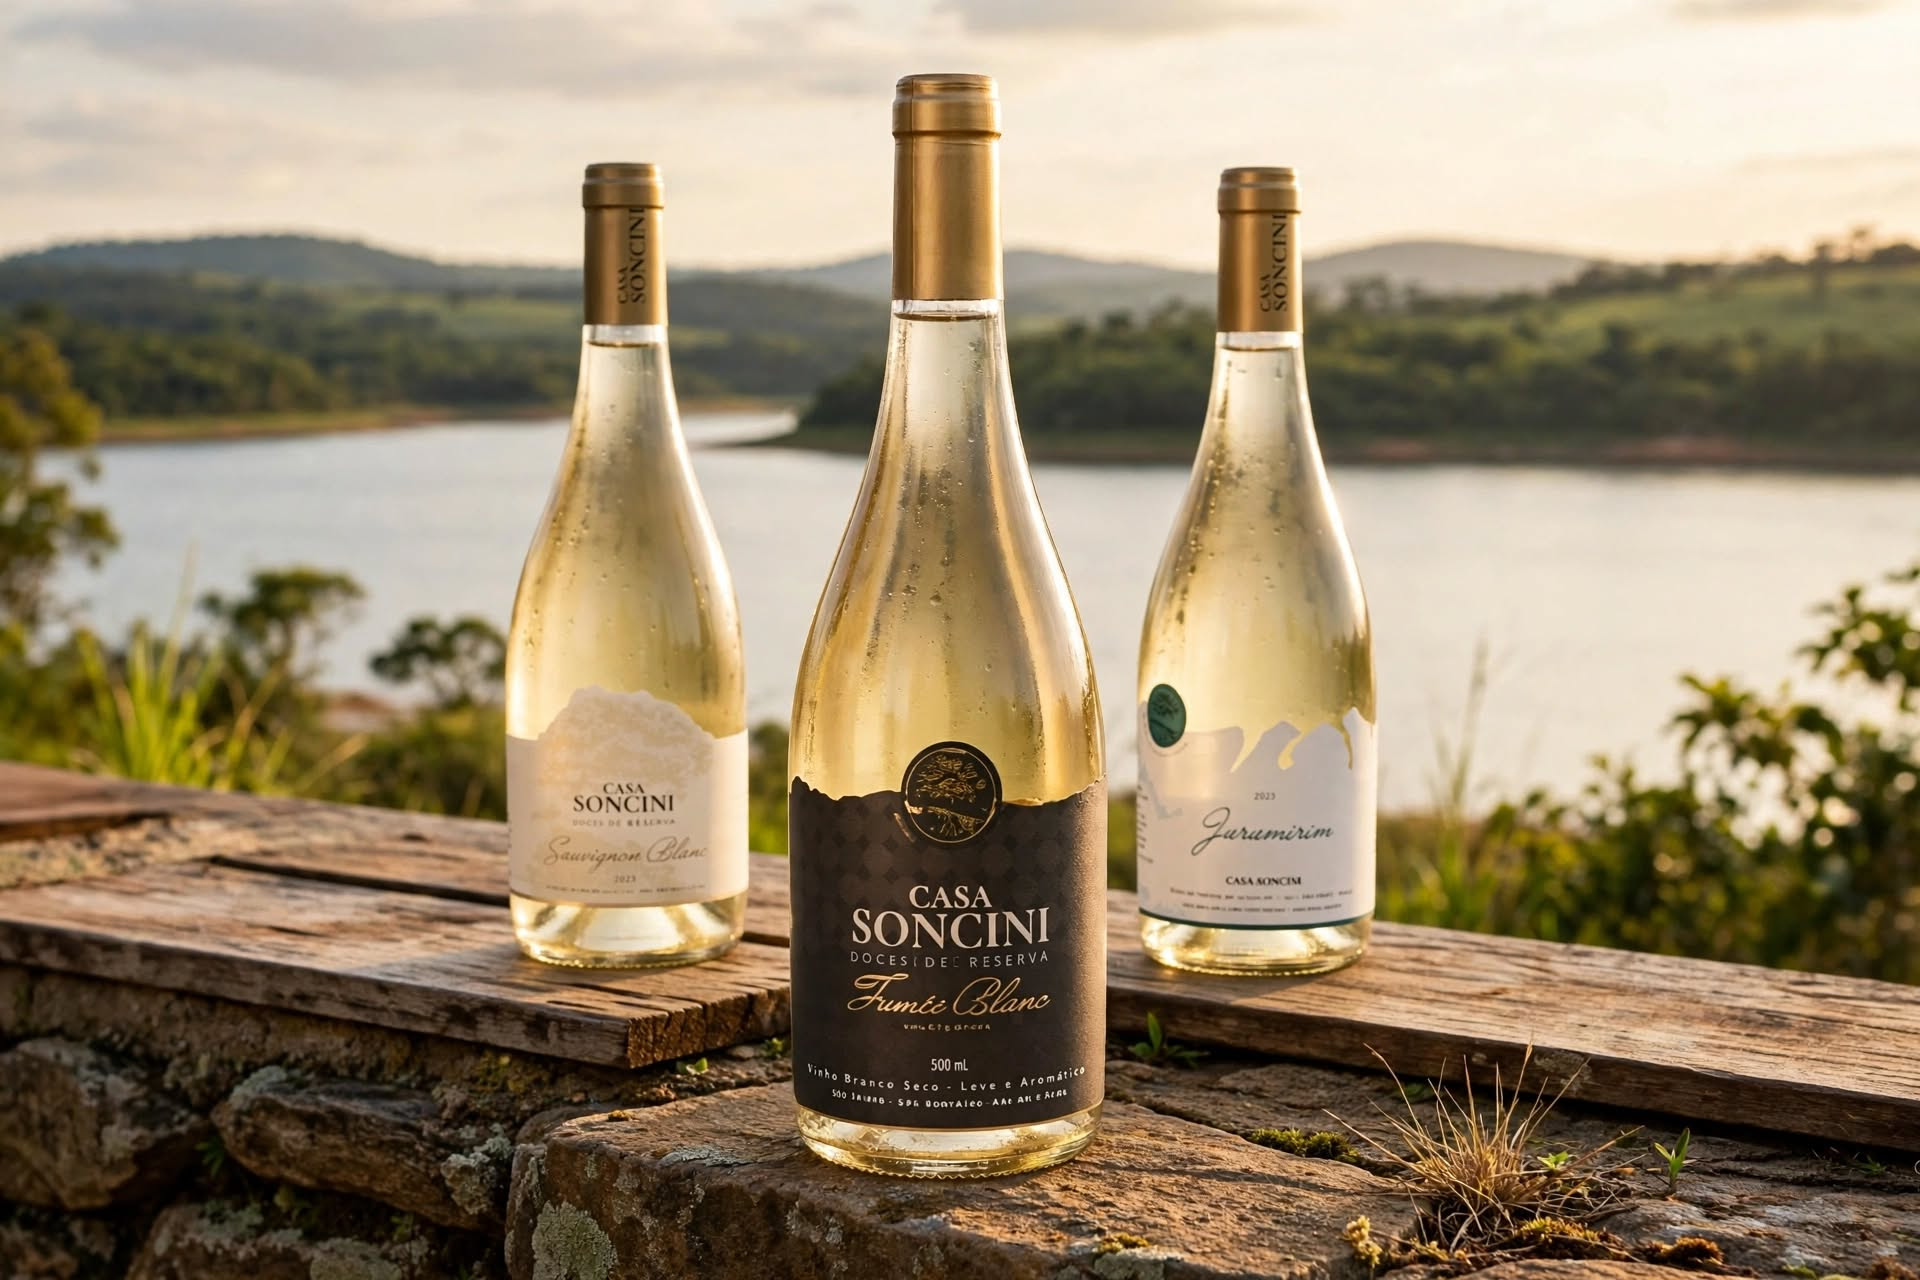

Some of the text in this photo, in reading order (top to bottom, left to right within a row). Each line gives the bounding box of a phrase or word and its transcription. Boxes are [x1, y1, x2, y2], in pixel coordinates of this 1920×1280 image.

[629, 208, 646, 304] SONCINI
[1272, 214, 1288, 312] SONCINI
[617, 266, 628, 304] CASA
[1260, 274, 1271, 312] CASA
[573, 795, 674, 814] SONCINI
[603, 782, 645, 795] CASA
[1191, 807, 1334, 857] Jurumirim
[544, 836, 708, 872] Sauvignon Blanc
[908, 885, 993, 909] CASA
[1225, 876, 1254, 886] CASA
[851, 907, 1050, 949] SONCINI
[969, 950, 1049, 968] RESERVA
[952, 976, 1051, 1016] Blanc
[807, 1063, 838, 1081] Vinho
[844, 1073, 894, 1090] Branco
[903, 1080, 939, 1091] Seco
[961, 1081, 996, 1091] Leve
[1005, 1081, 1012, 1089] e
[1020, 1066, 1086, 1088] Aromático
[930, 1059, 969, 1072] 500 mL
